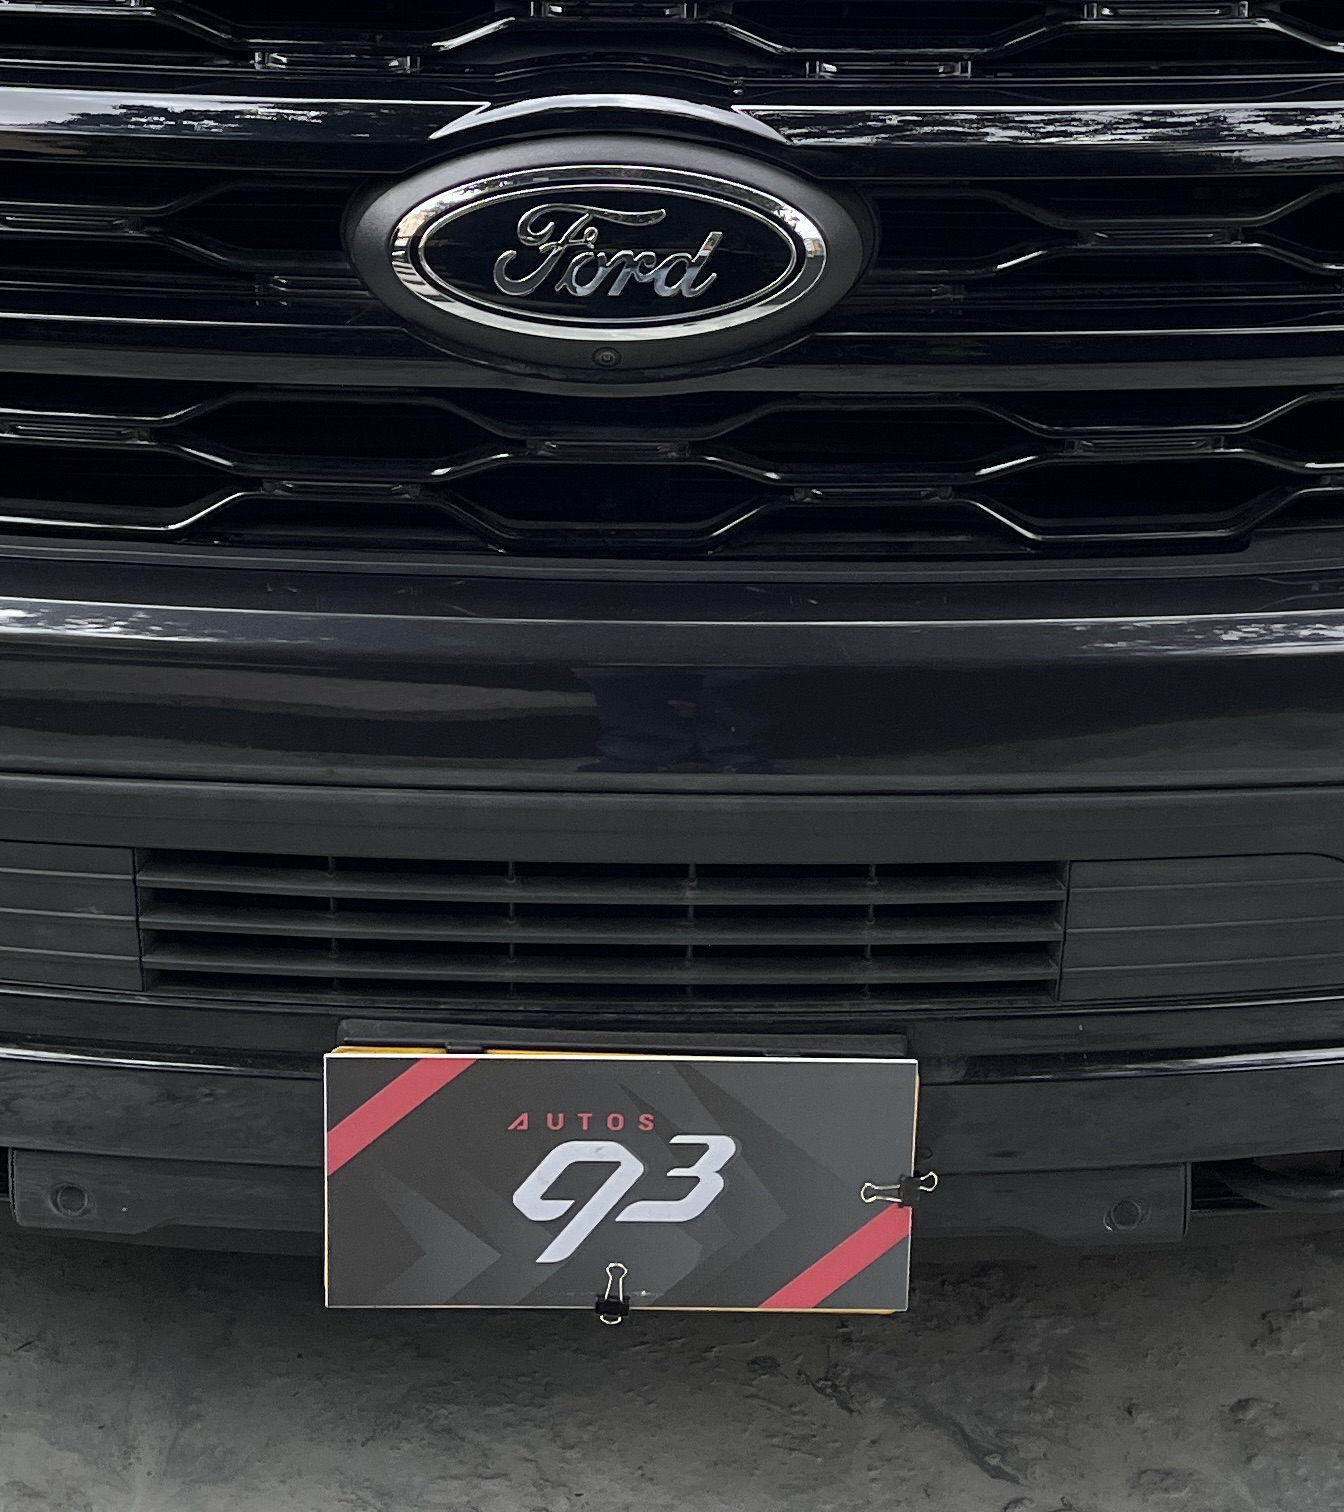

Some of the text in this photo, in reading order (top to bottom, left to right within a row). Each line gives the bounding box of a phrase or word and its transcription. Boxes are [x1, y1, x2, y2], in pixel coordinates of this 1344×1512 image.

[493, 202, 723, 298] Ford
[508, 1112, 655, 1131] AUTOS
[512, 1134, 736, 1263] 93
